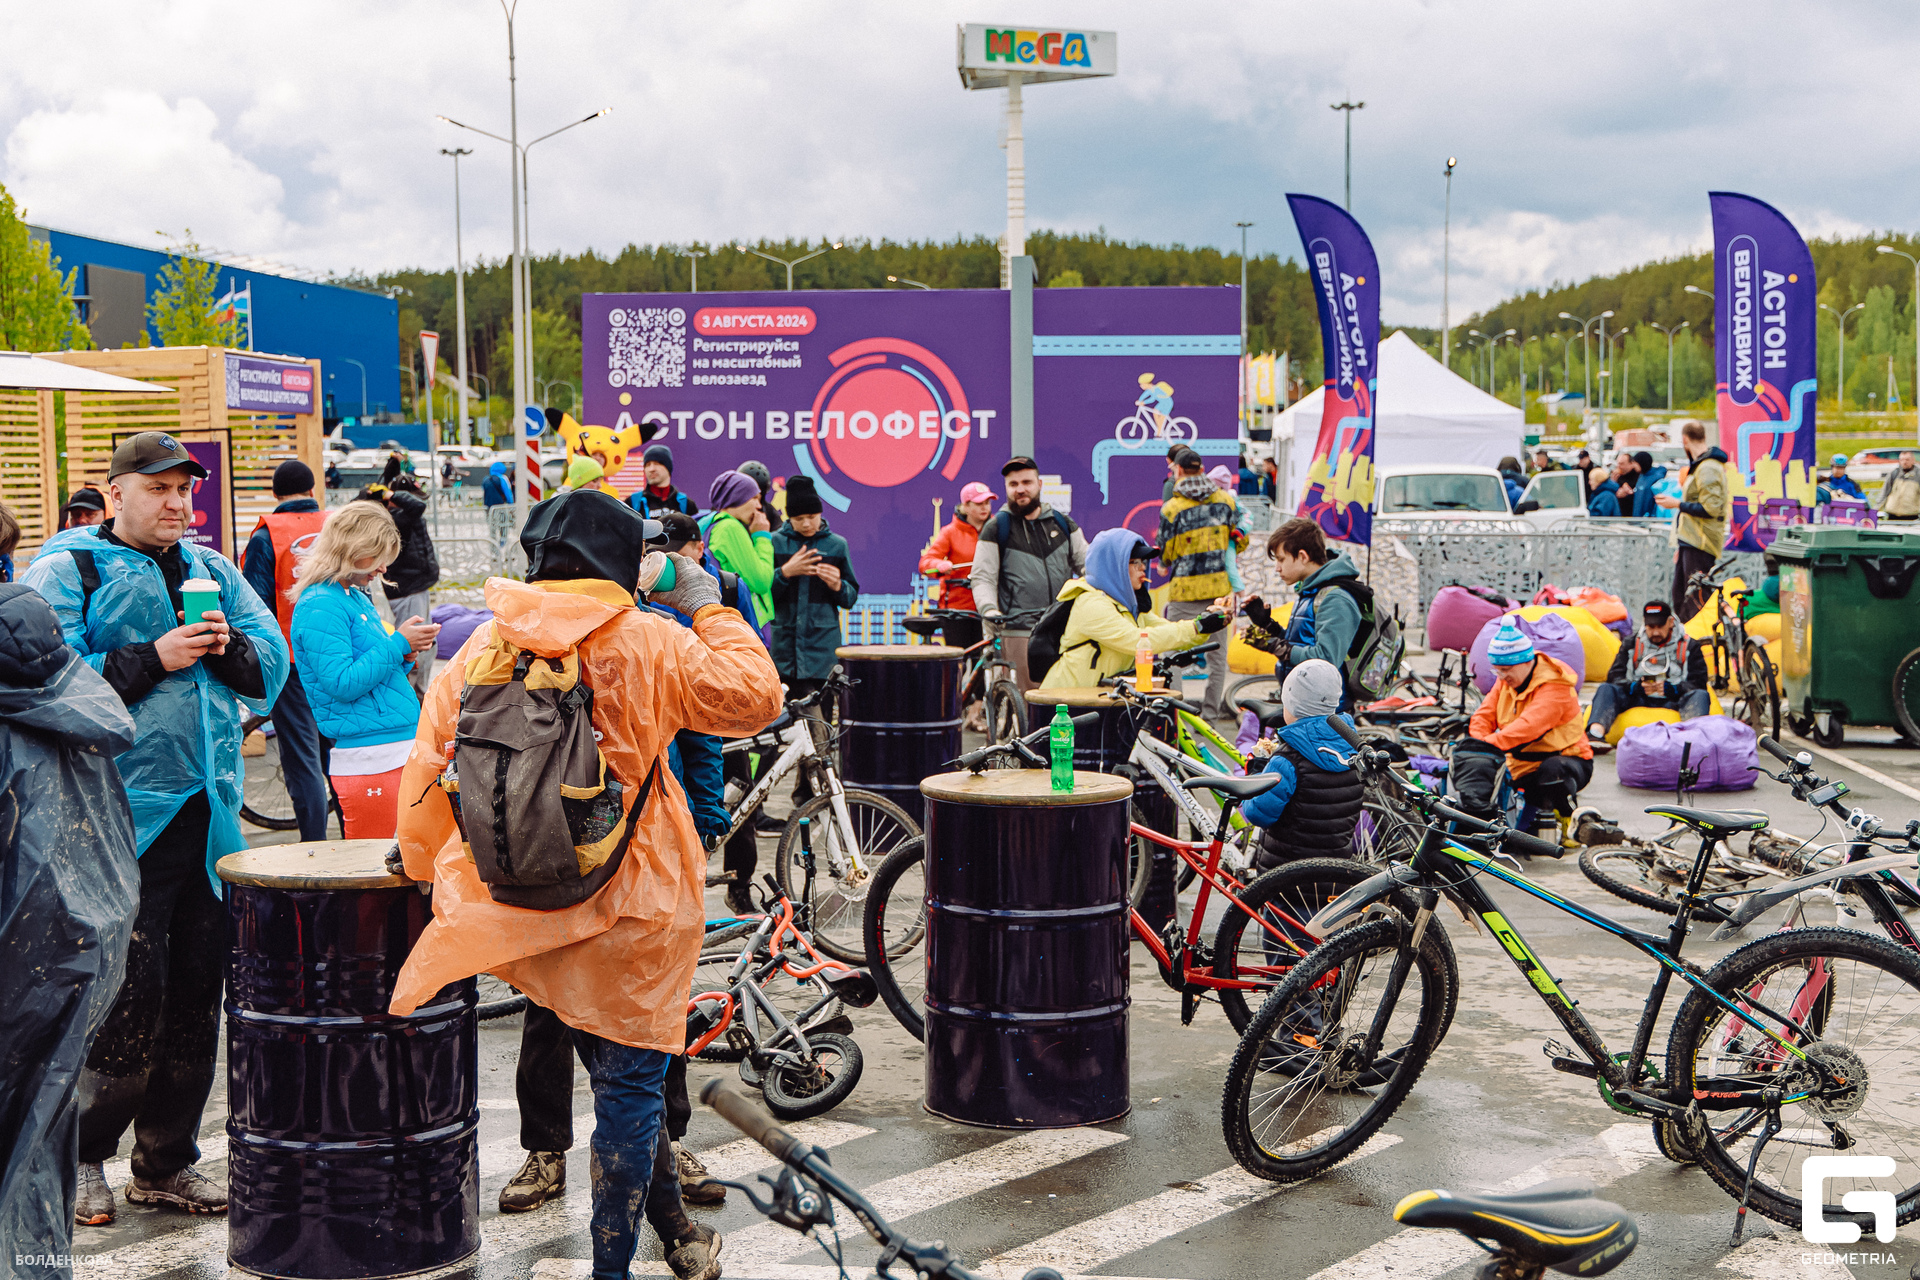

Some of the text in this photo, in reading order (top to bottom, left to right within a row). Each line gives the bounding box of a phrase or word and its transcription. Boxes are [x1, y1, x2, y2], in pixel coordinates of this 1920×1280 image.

[702, 314, 808, 328] 3 АВГУСТА 2024
[1339, 272, 1369, 367] АСТОН
[1733, 249, 1753, 391] ВЕЛОДВИЖ
[1762, 270, 1787, 369] АСТОН
[693, 337, 800, 355] Регистрируйся
[692, 354, 802, 369] на масштабный
[692, 374, 767, 386] велозаезд
[614, 409, 997, 440] АСТОН ВЕЛОФЕСТ
